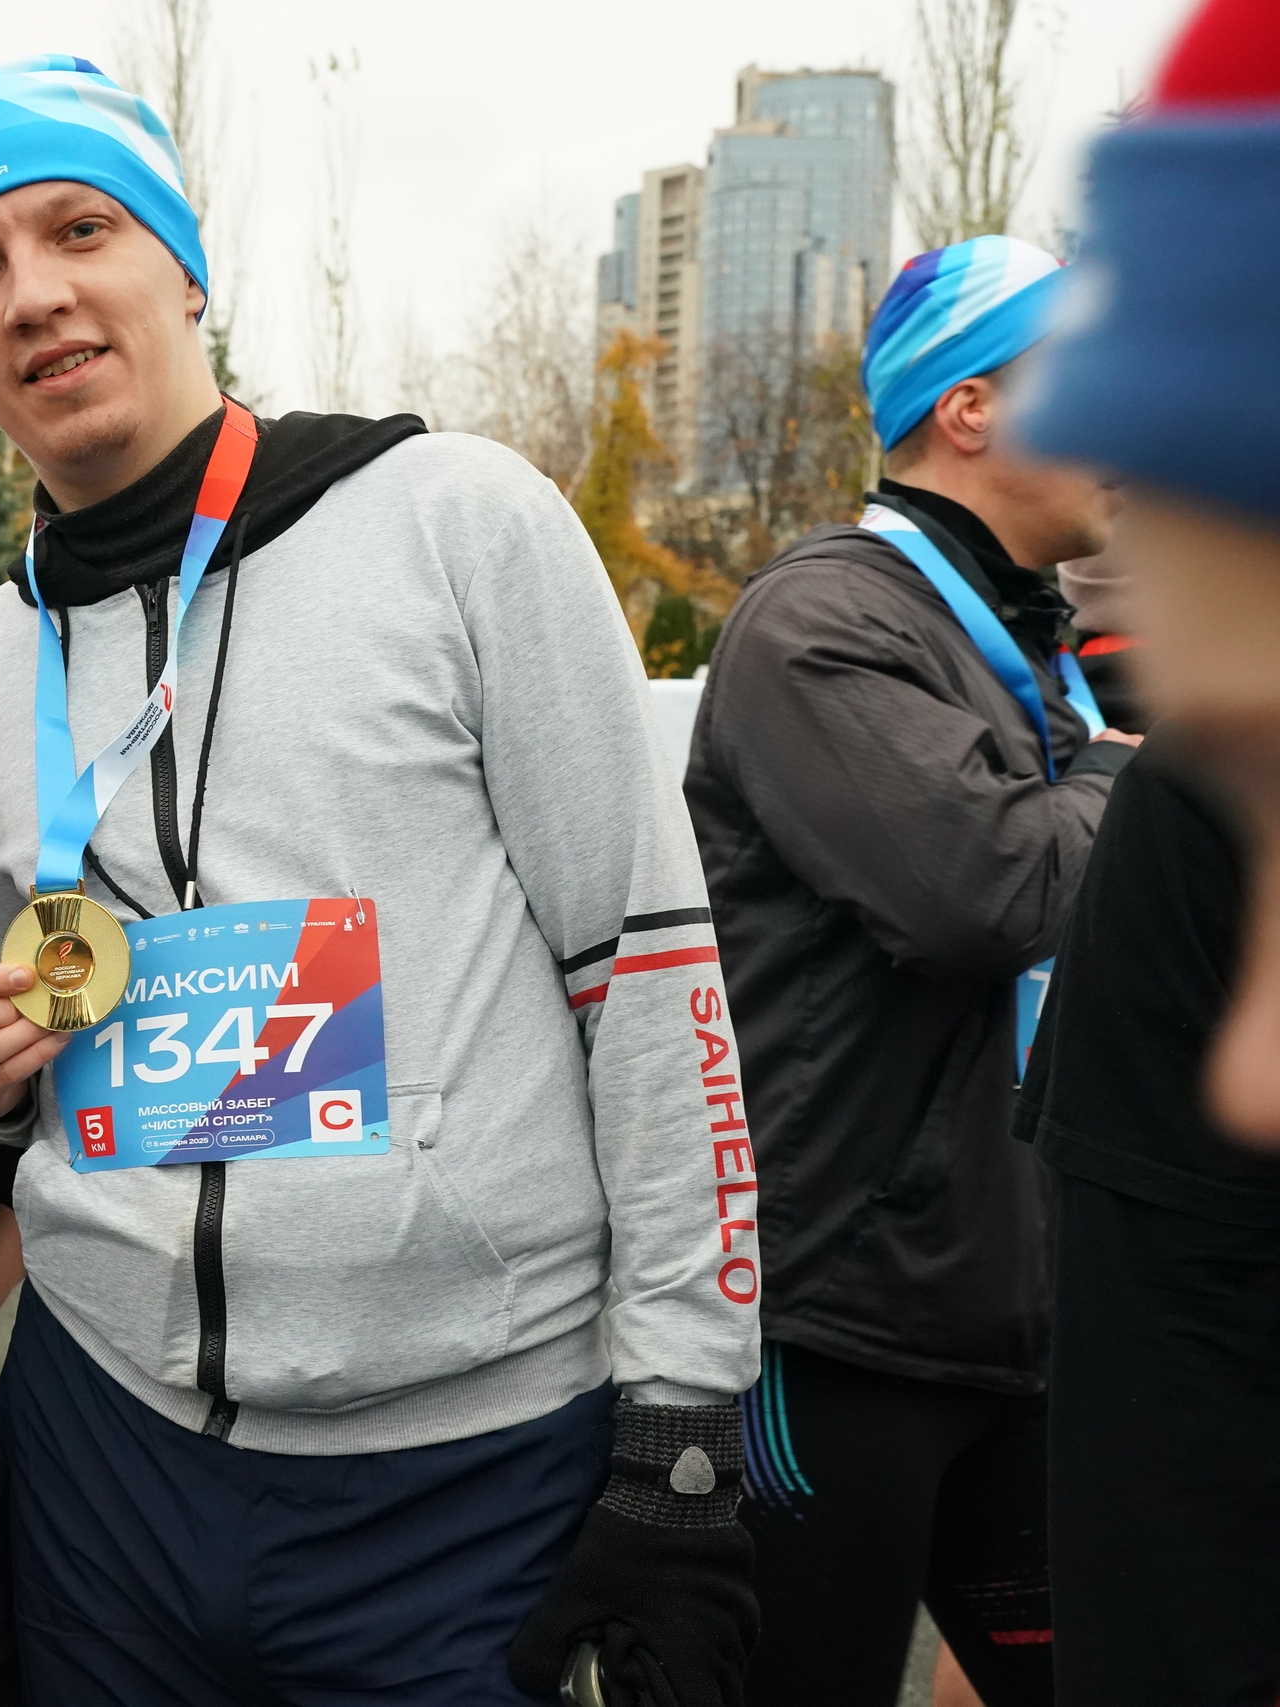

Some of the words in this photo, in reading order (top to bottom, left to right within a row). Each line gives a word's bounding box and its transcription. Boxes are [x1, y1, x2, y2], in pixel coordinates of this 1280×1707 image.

[120, 706, 158, 756] СПОРТИВНАЯ
[125, 702, 155, 740] ДЕРЖАВА
[141, 709, 163, 741] РОССИЯ
[118, 962, 299, 1006] МАКСИМ
[94, 1002, 333, 1088] 1347
[138, 1098, 222, 1117] МАССОВЫЙ
[226, 1097, 275, 1110] ЗАБЕГ
[85, 1114, 104, 1140] 5
[142, 1115, 209, 1131] «ЧИСТЫЙ
[212, 1114, 273, 1127] СПОРТ»
[91, 1142, 106, 1152] КМ
[159, 1139, 188, 1147] ноября
[229, 1134, 267, 1142] САМАРА
[690, 986, 758, 1305] SAIHELLO
